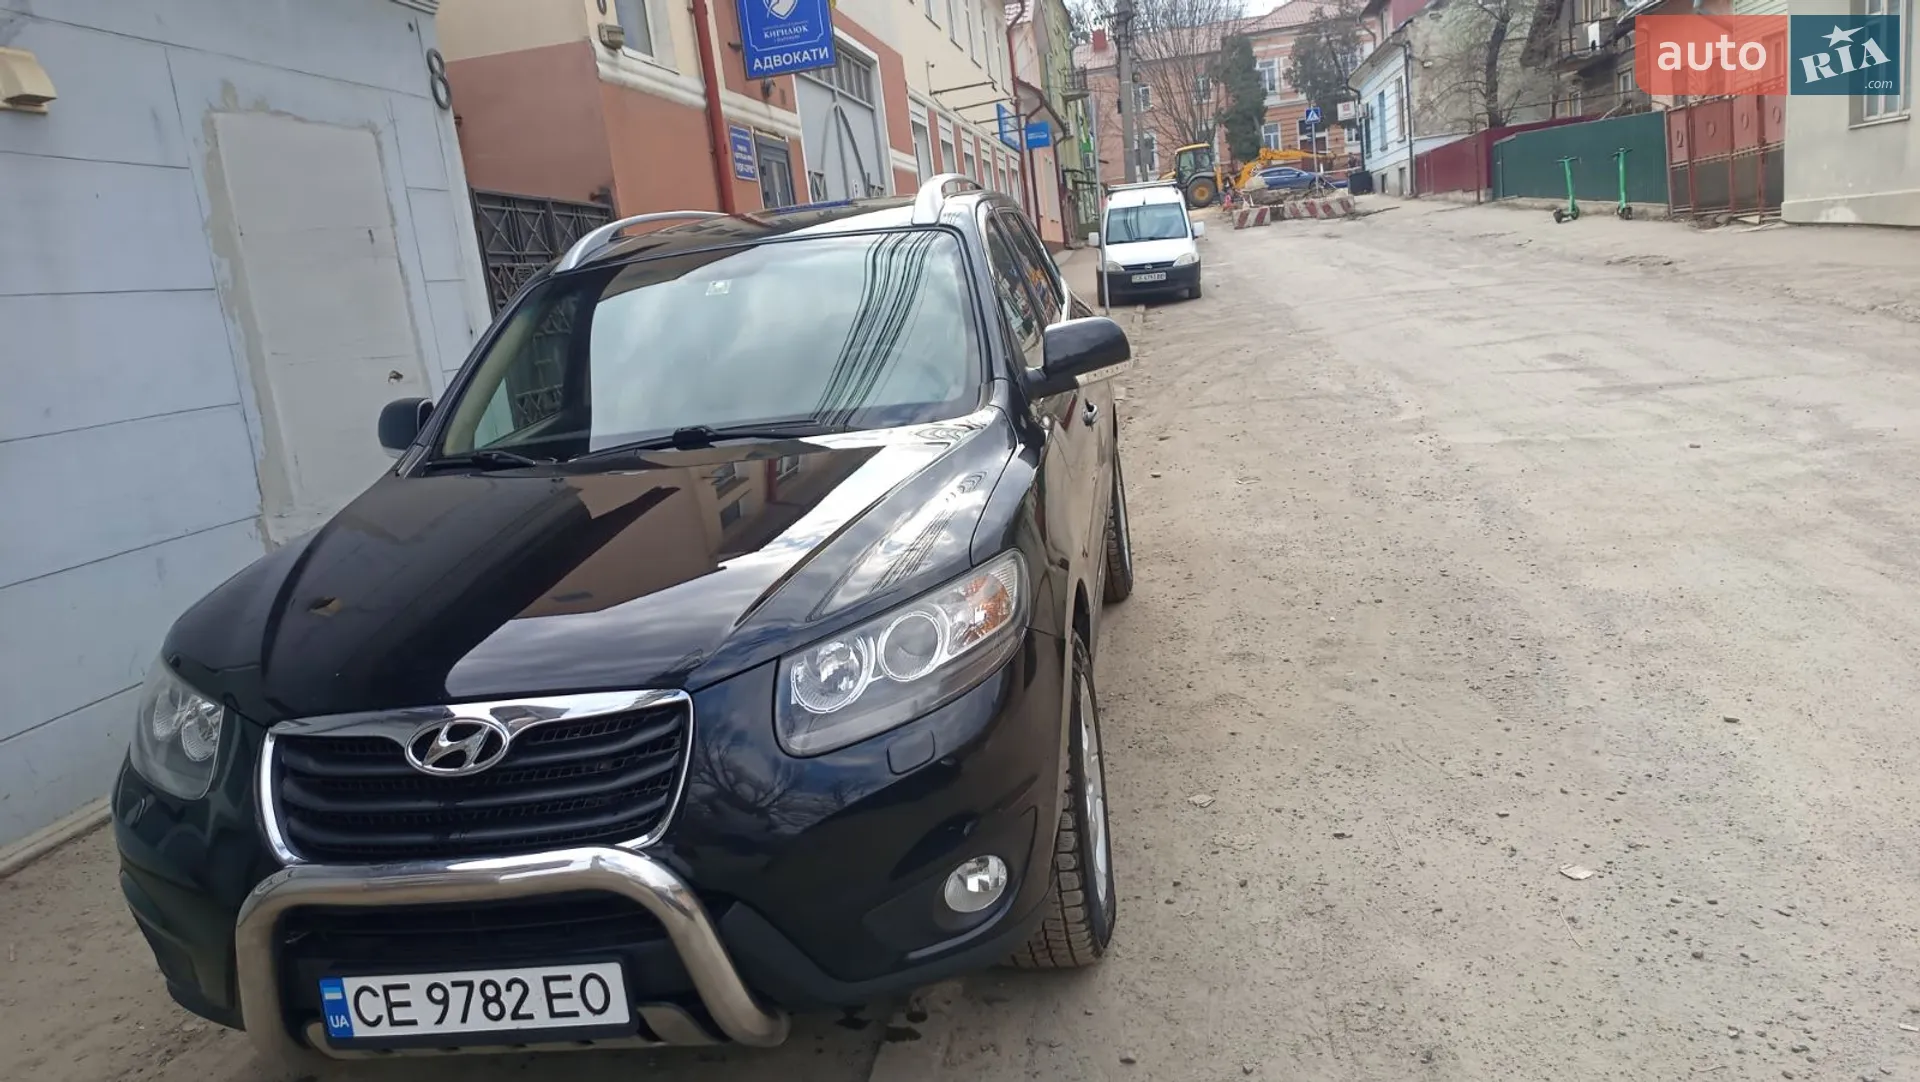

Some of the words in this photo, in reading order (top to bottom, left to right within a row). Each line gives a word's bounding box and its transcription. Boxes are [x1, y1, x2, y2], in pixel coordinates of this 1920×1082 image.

[753, 46, 829, 70] АДВОКАТИ
[354, 985, 418, 1028] CE
[425, 979, 535, 1026] 9782
[543, 973, 612, 1018] EO
[330, 1014, 349, 1029] UA
